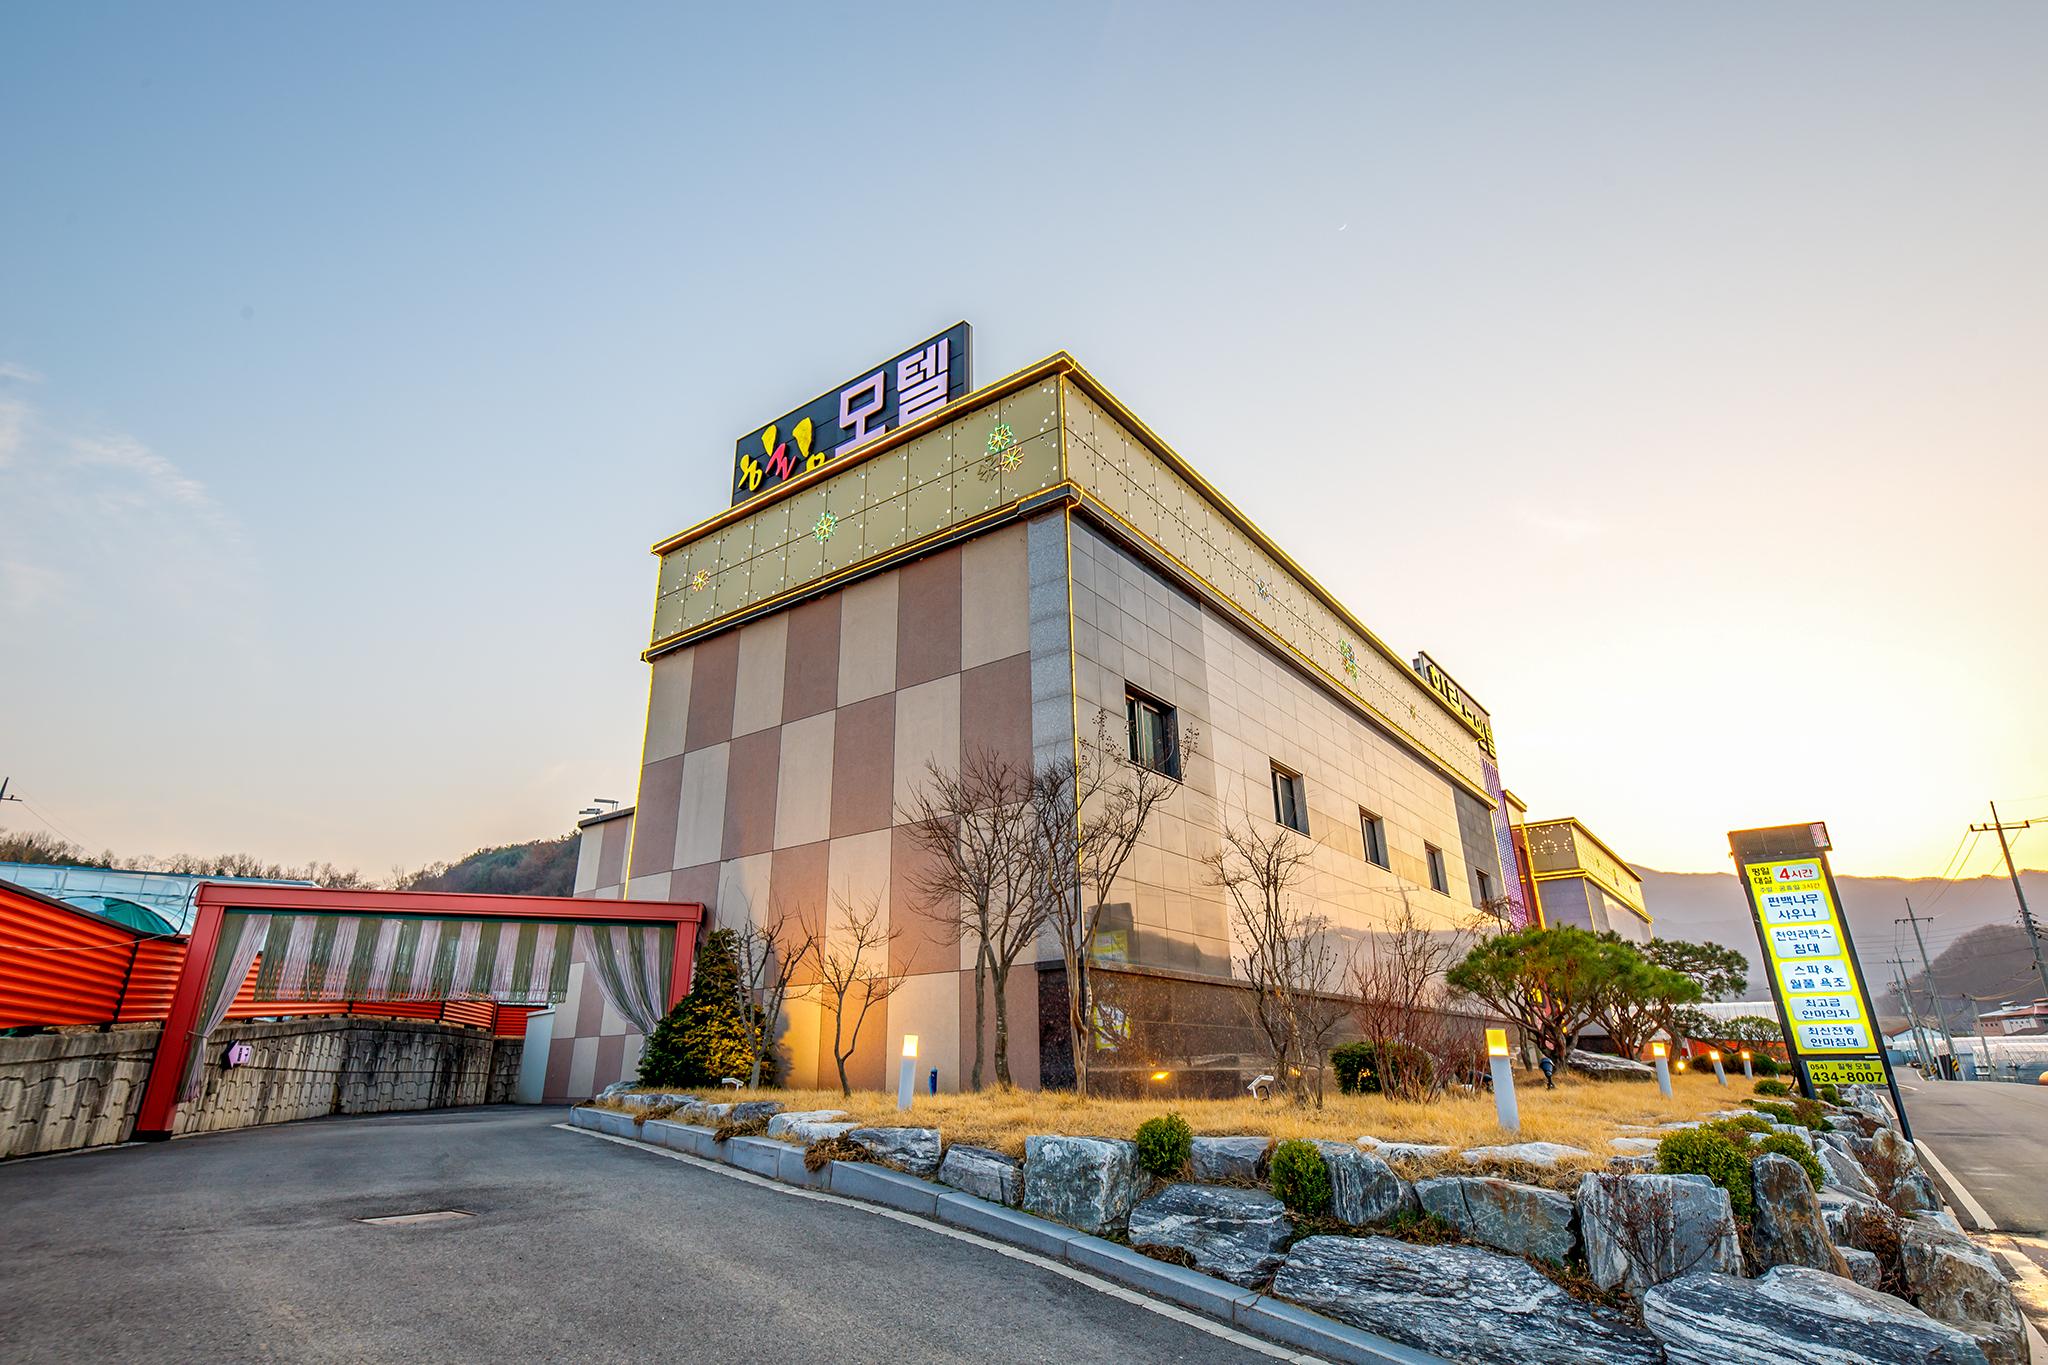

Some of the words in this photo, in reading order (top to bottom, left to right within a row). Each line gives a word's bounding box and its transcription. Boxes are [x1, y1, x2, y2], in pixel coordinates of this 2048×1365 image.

[835, 337, 949, 458] 모텔
[1751, 867, 1770, 876] 평일
[1779, 867, 1813, 880] 4시간
[1754, 876, 1773, 885] 대실
[1768, 893, 1819, 907] 편백나무
[1778, 908, 1816, 920] 사우나
[1776, 928, 1832, 942] 천연라텍스
[1793, 943, 1820, 955] 침대
[1794, 965, 1819, 975] 스파
[1824, 965, 1833, 973] &
[1820, 977, 1846, 987] 욕조
[1805, 998, 1841, 1007] 최고급
[1801, 1009, 1850, 1019] 안마의자
[1808, 1026, 1854, 1036] 최신전동
[1810, 1037, 1859, 1047] 안마침대
[1812, 1071, 1883, 1082] 434-8007
